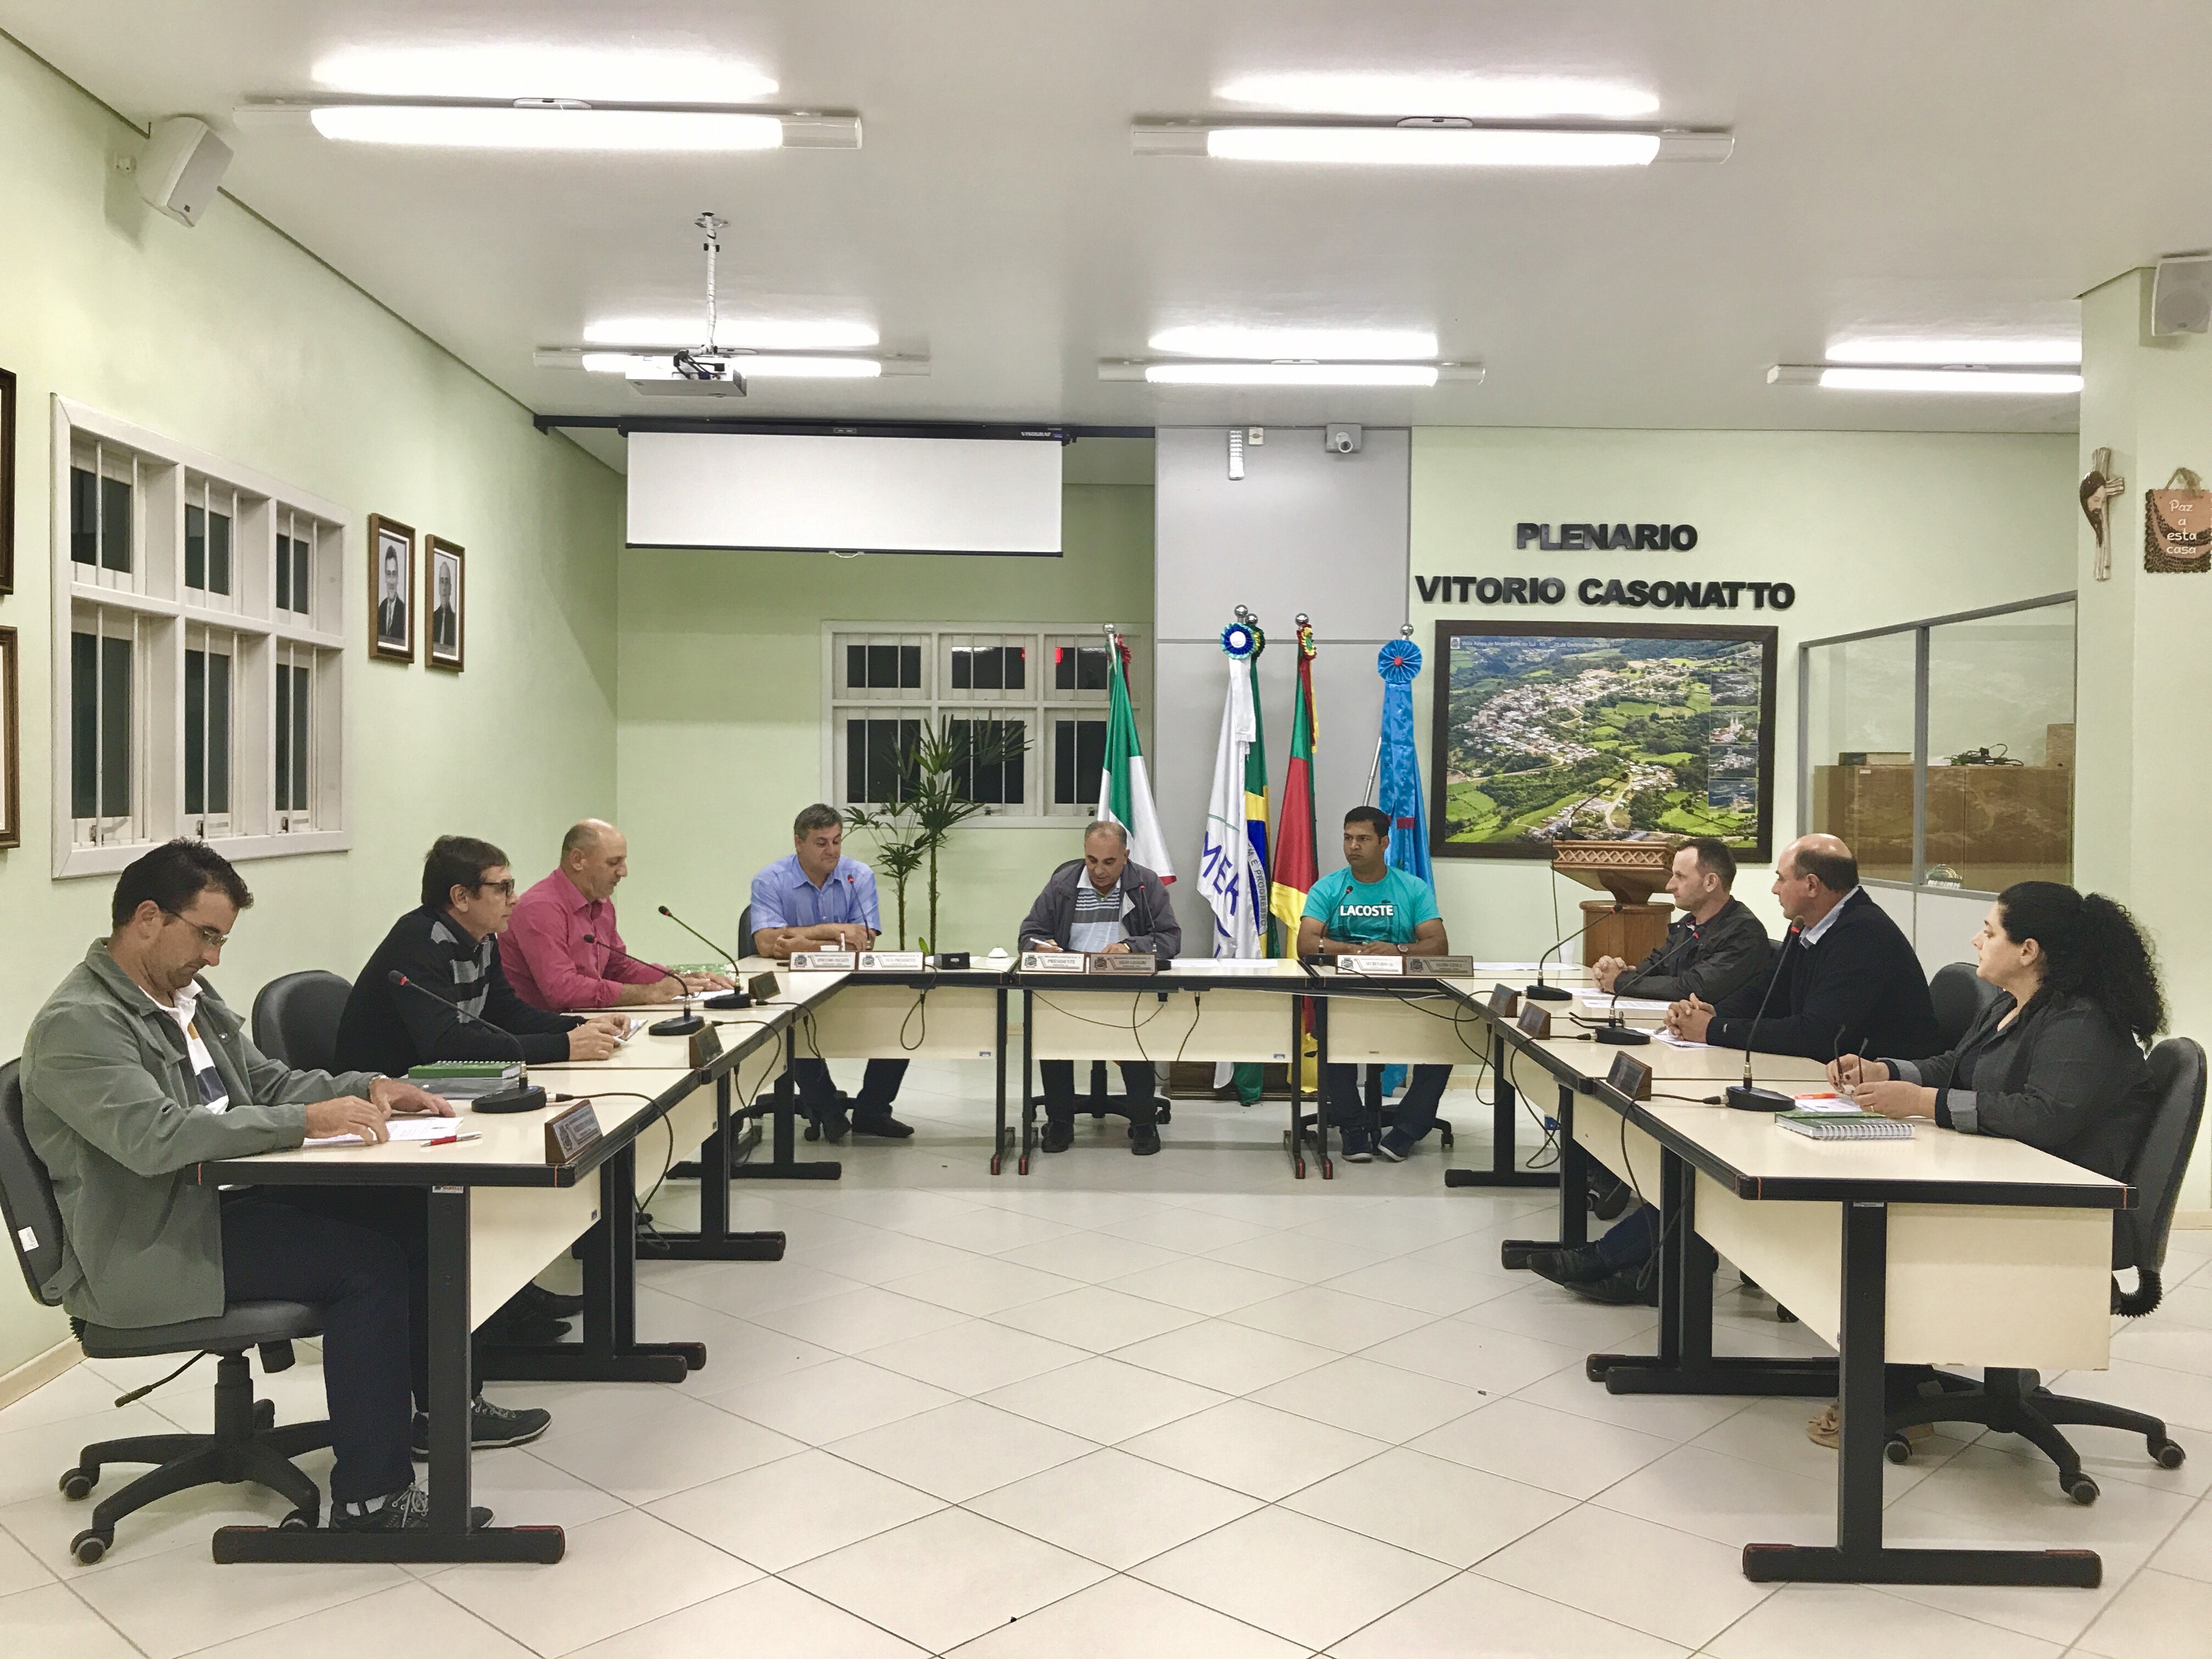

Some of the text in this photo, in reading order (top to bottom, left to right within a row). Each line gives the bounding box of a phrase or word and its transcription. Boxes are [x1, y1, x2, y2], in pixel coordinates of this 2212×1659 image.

[2169, 499, 2193, 512] Paz
[2178, 517, 2186, 526] a
[1516, 523, 1697, 550] PLENARIO
[2167, 528, 2197, 540] esta
[2166, 546, 2196, 554] casa
[1415, 576, 1795, 609] VITORIO CASONATTO
[1340, 905, 1394, 917] LACOSTE
